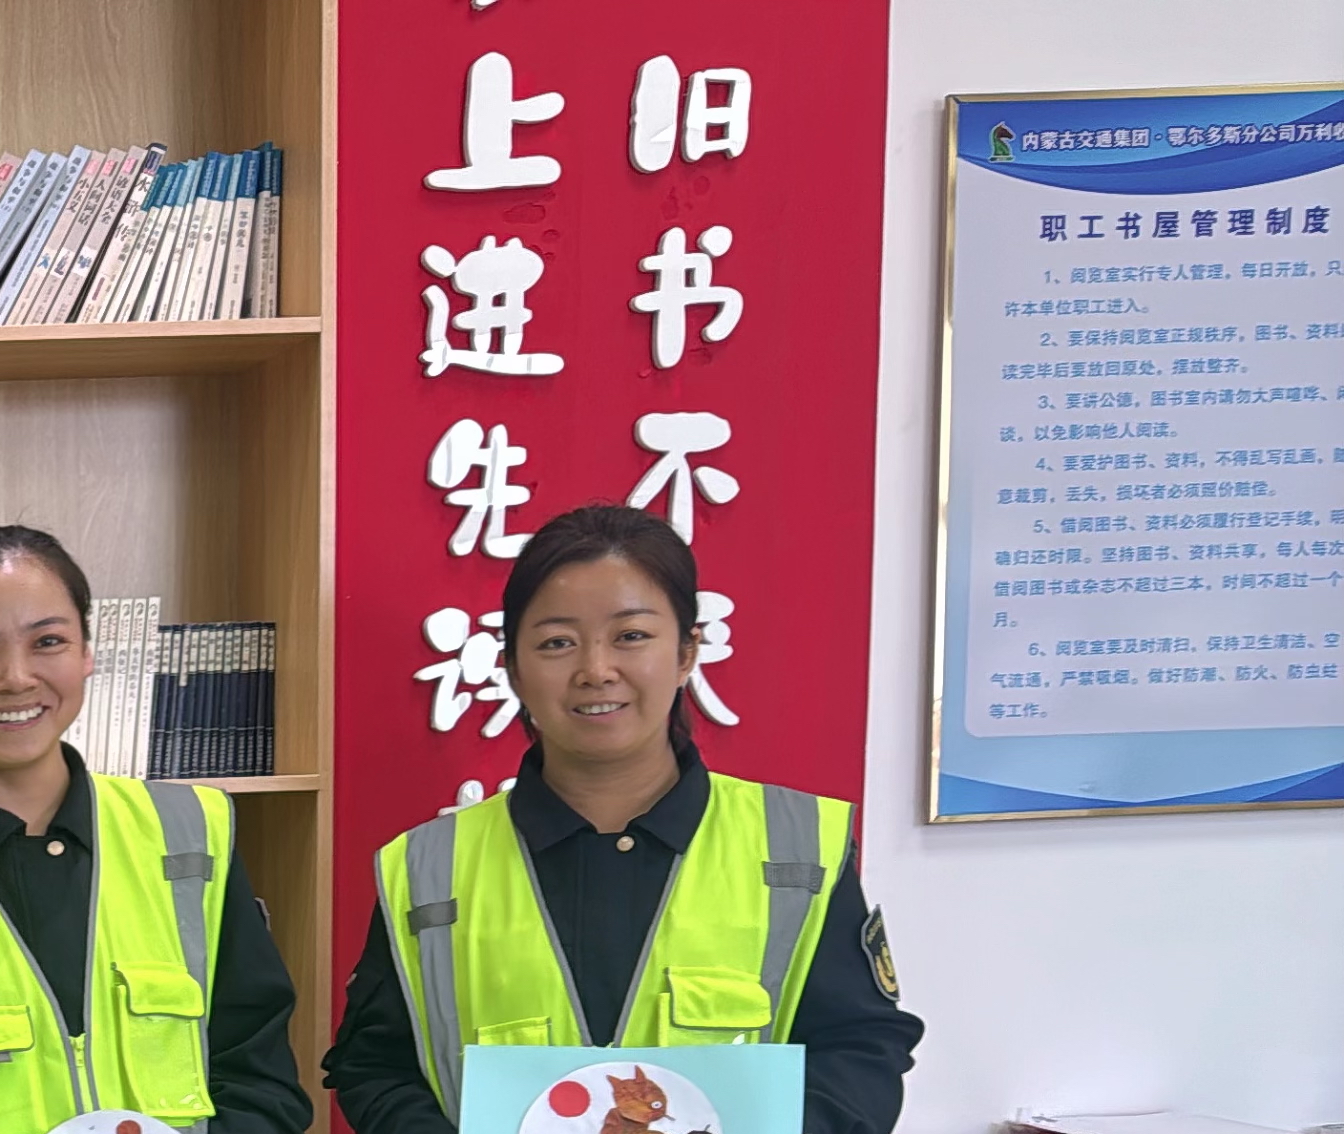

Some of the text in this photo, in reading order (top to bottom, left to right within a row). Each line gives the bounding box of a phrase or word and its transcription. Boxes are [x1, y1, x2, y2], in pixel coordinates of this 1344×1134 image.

[1039, 205, 1331, 243] 职工书屋管理制度
[1040, 323, 1344, 348] 2、要保持阅览室正规秩序，图书、资料
[414, 0, 567, 822] 上进先读
[988, 702, 1049, 721] 等工作。
